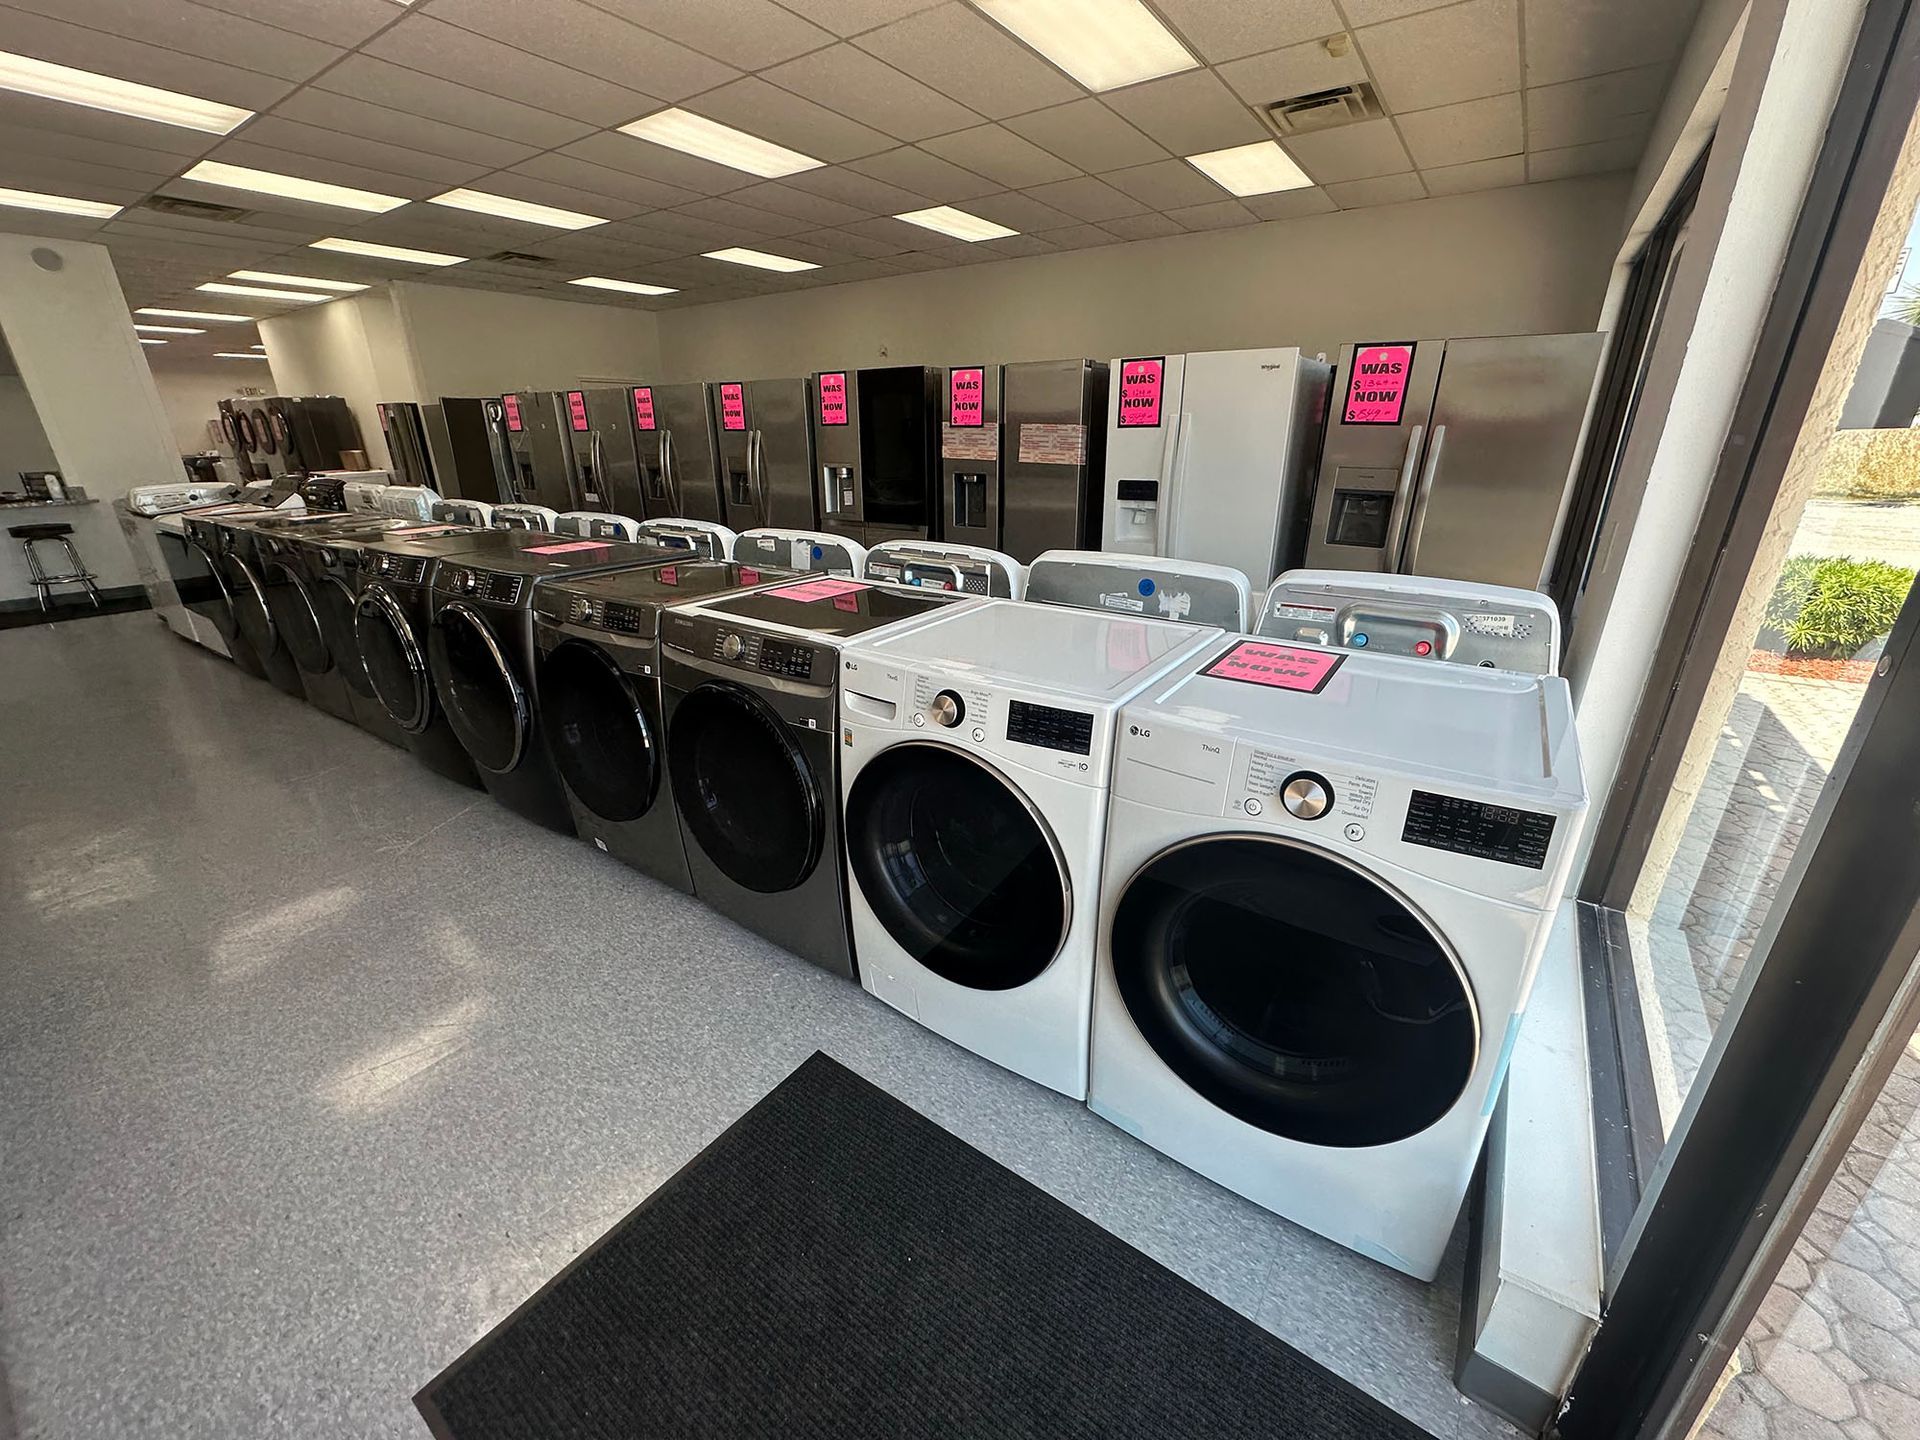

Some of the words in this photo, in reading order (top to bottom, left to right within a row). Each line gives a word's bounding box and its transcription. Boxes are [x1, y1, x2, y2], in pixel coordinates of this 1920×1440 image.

[1361, 362, 1402, 374] WAS
[1126, 373, 1156, 385] WAS
[823, 384, 842, 393] WAS
[956, 381, 979, 390] WAS
[1354, 391, 1398, 402] NOW
[823, 402, 843, 411] NOW
[955, 402, 979, 411] NOW
[1124, 398, 1155, 408] NOW
[1244, 648, 1319, 664] WAS
[1226, 660, 1310, 677] NOW
[1140, 728, 1151, 738] LG
[1202, 743, 1220, 754] ThinQ
